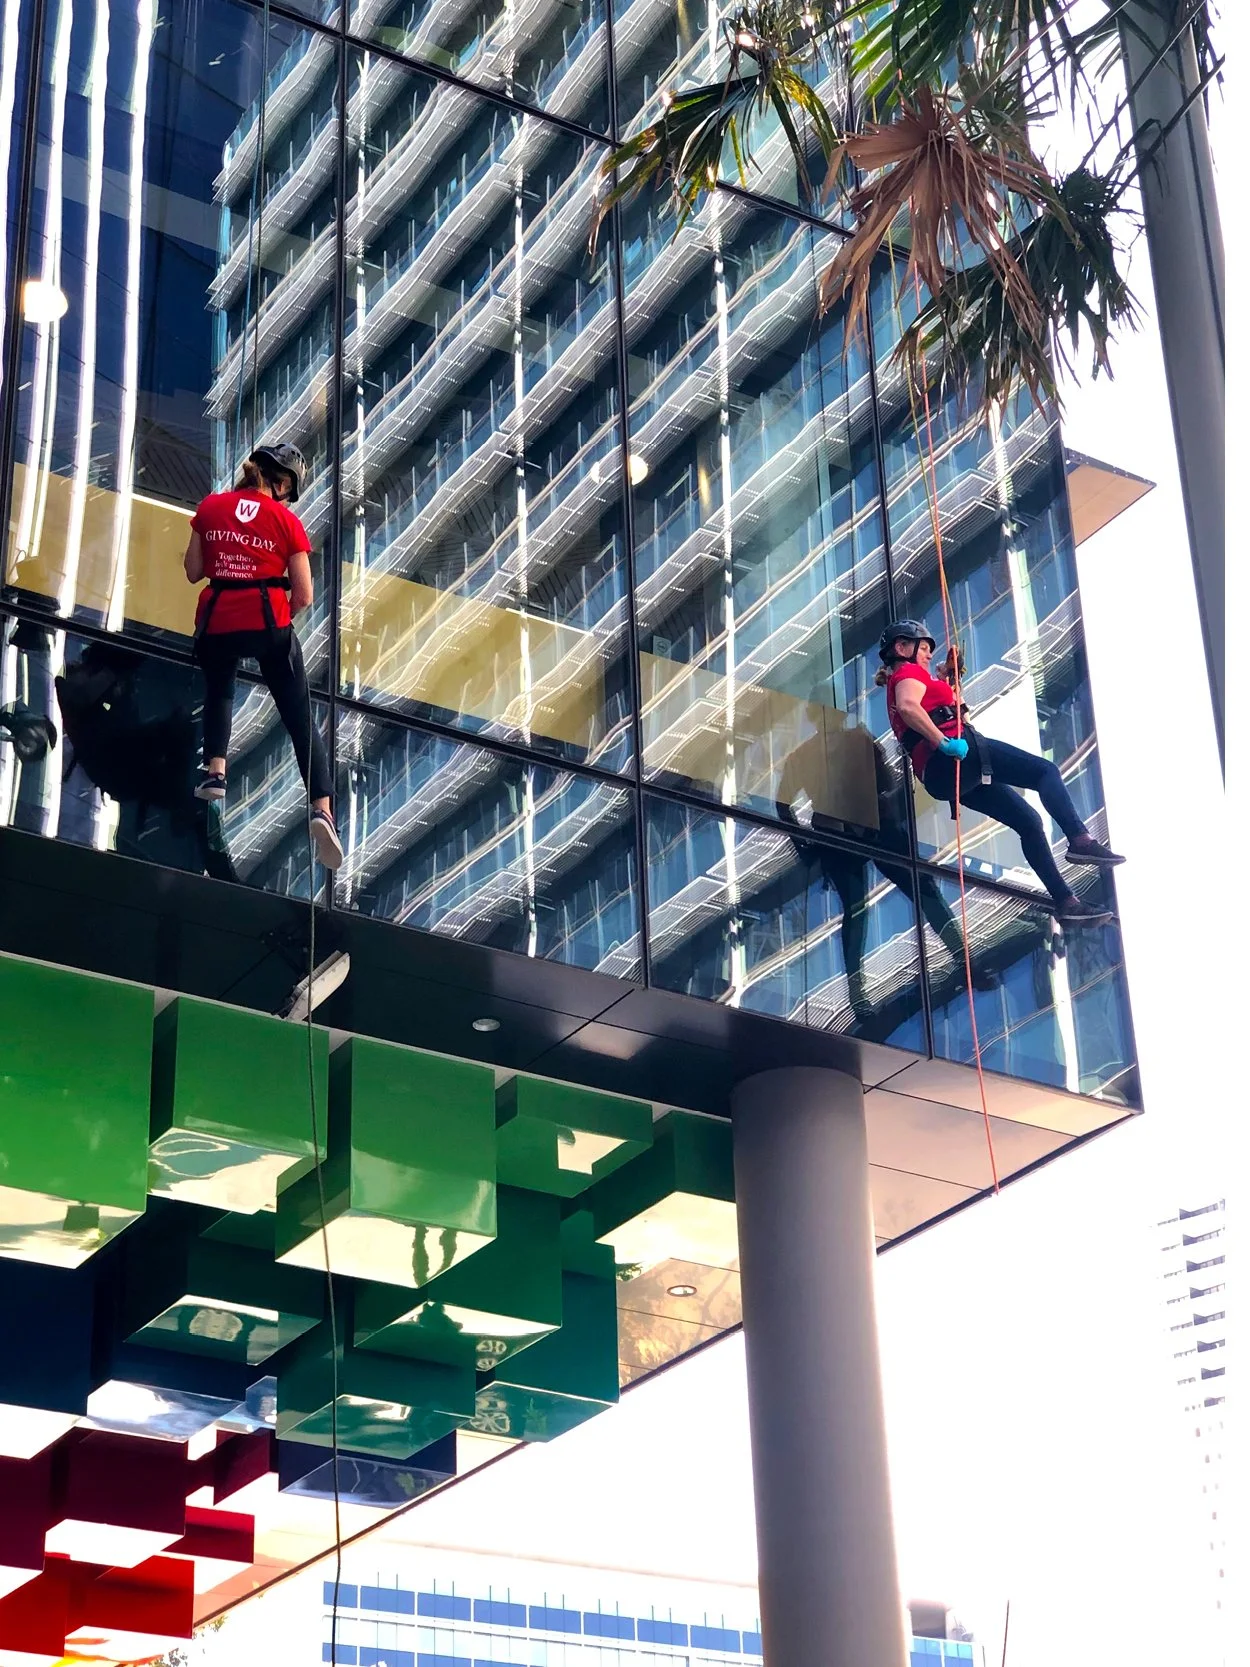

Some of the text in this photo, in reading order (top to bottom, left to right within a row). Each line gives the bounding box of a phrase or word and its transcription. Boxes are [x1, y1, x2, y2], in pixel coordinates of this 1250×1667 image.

[240, 502, 257, 517] W
[205, 530, 250, 545] GIVING
[229, 562, 250, 571] make
